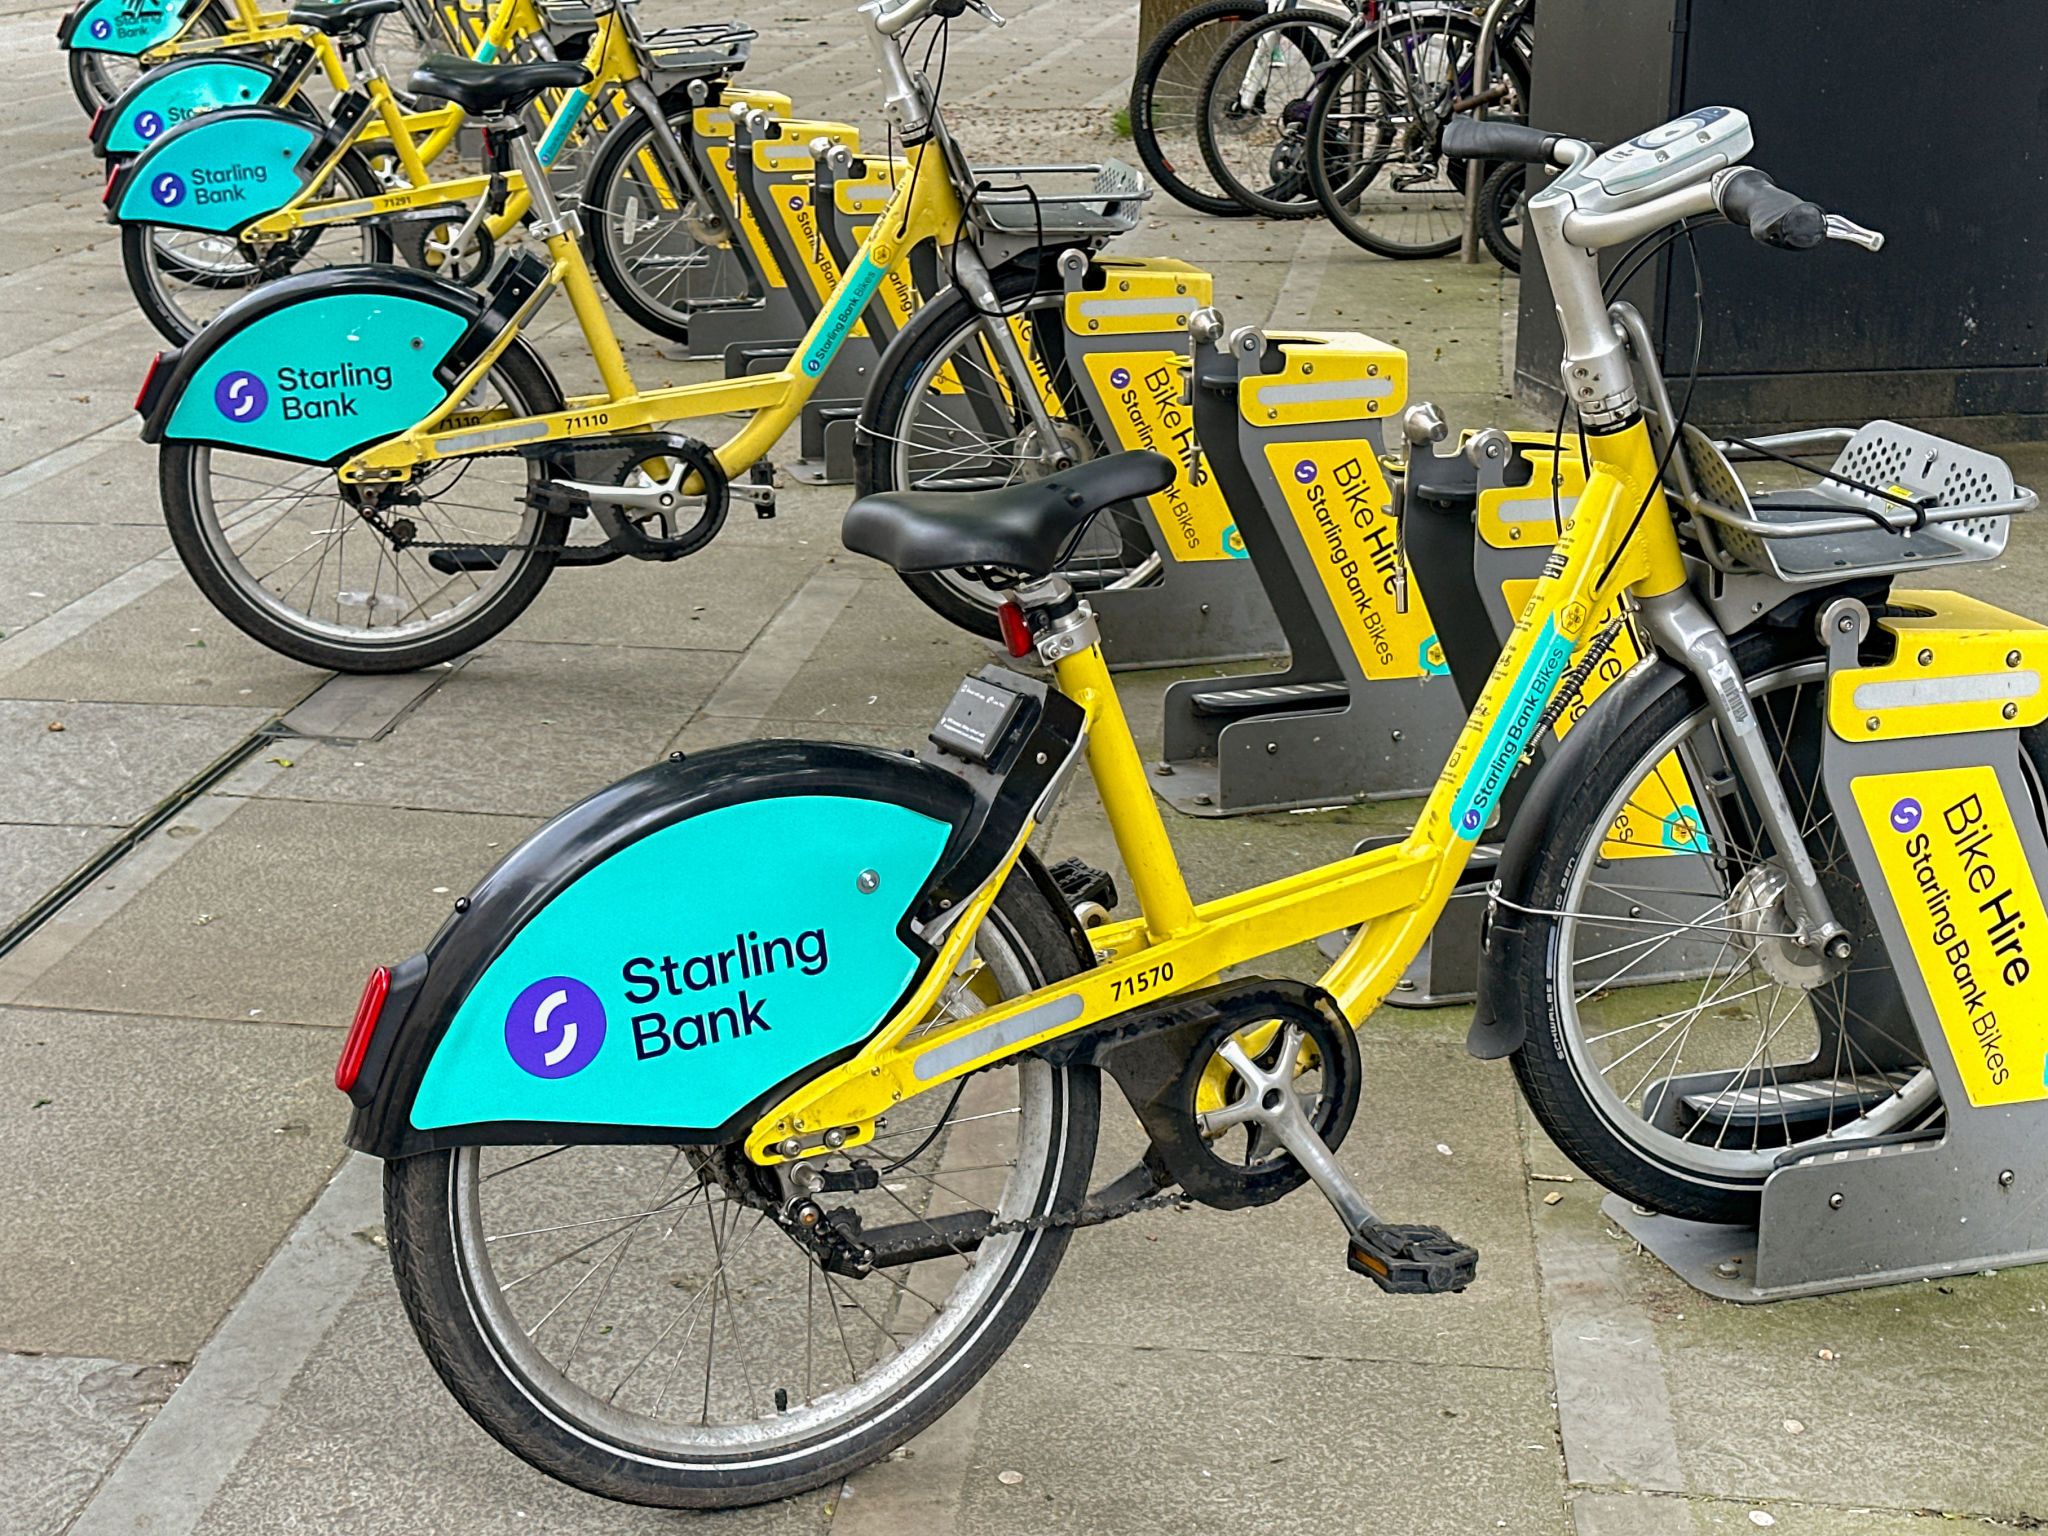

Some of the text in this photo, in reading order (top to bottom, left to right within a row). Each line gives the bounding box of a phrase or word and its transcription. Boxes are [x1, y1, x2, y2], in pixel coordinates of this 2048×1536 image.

[191, 164, 267, 185] Starling
[195, 185, 246, 204] Bank
[384, 196, 412, 208] 71291
[820, 261, 838, 291] Ban
[889, 271, 912, 313] arling
[816, 271, 876, 359] Starling Bank Bikes
[278, 362, 392, 391] Starling
[1144, 367, 1181, 429] Bike
[282, 394, 358, 421] Bank
[566, 413, 608, 430] 71110
[1332, 458, 1374, 529] Bike
[1173, 501, 1200, 549] Bikes
[1306, 484, 1394, 666] Starling Bank Bikes
[1473, 741, 1518, 809] Starling
[1508, 695, 1540, 741] Bank
[1532, 648, 1563, 695] Bikes
[1943, 793, 2031, 987] Bike Hire
[621, 927, 829, 1006] Starling
[1109, 962, 1174, 1002] 71570
[1906, 833, 2010, 1086] Starling Bank Bikes
[629, 991, 772, 1062] Bank
